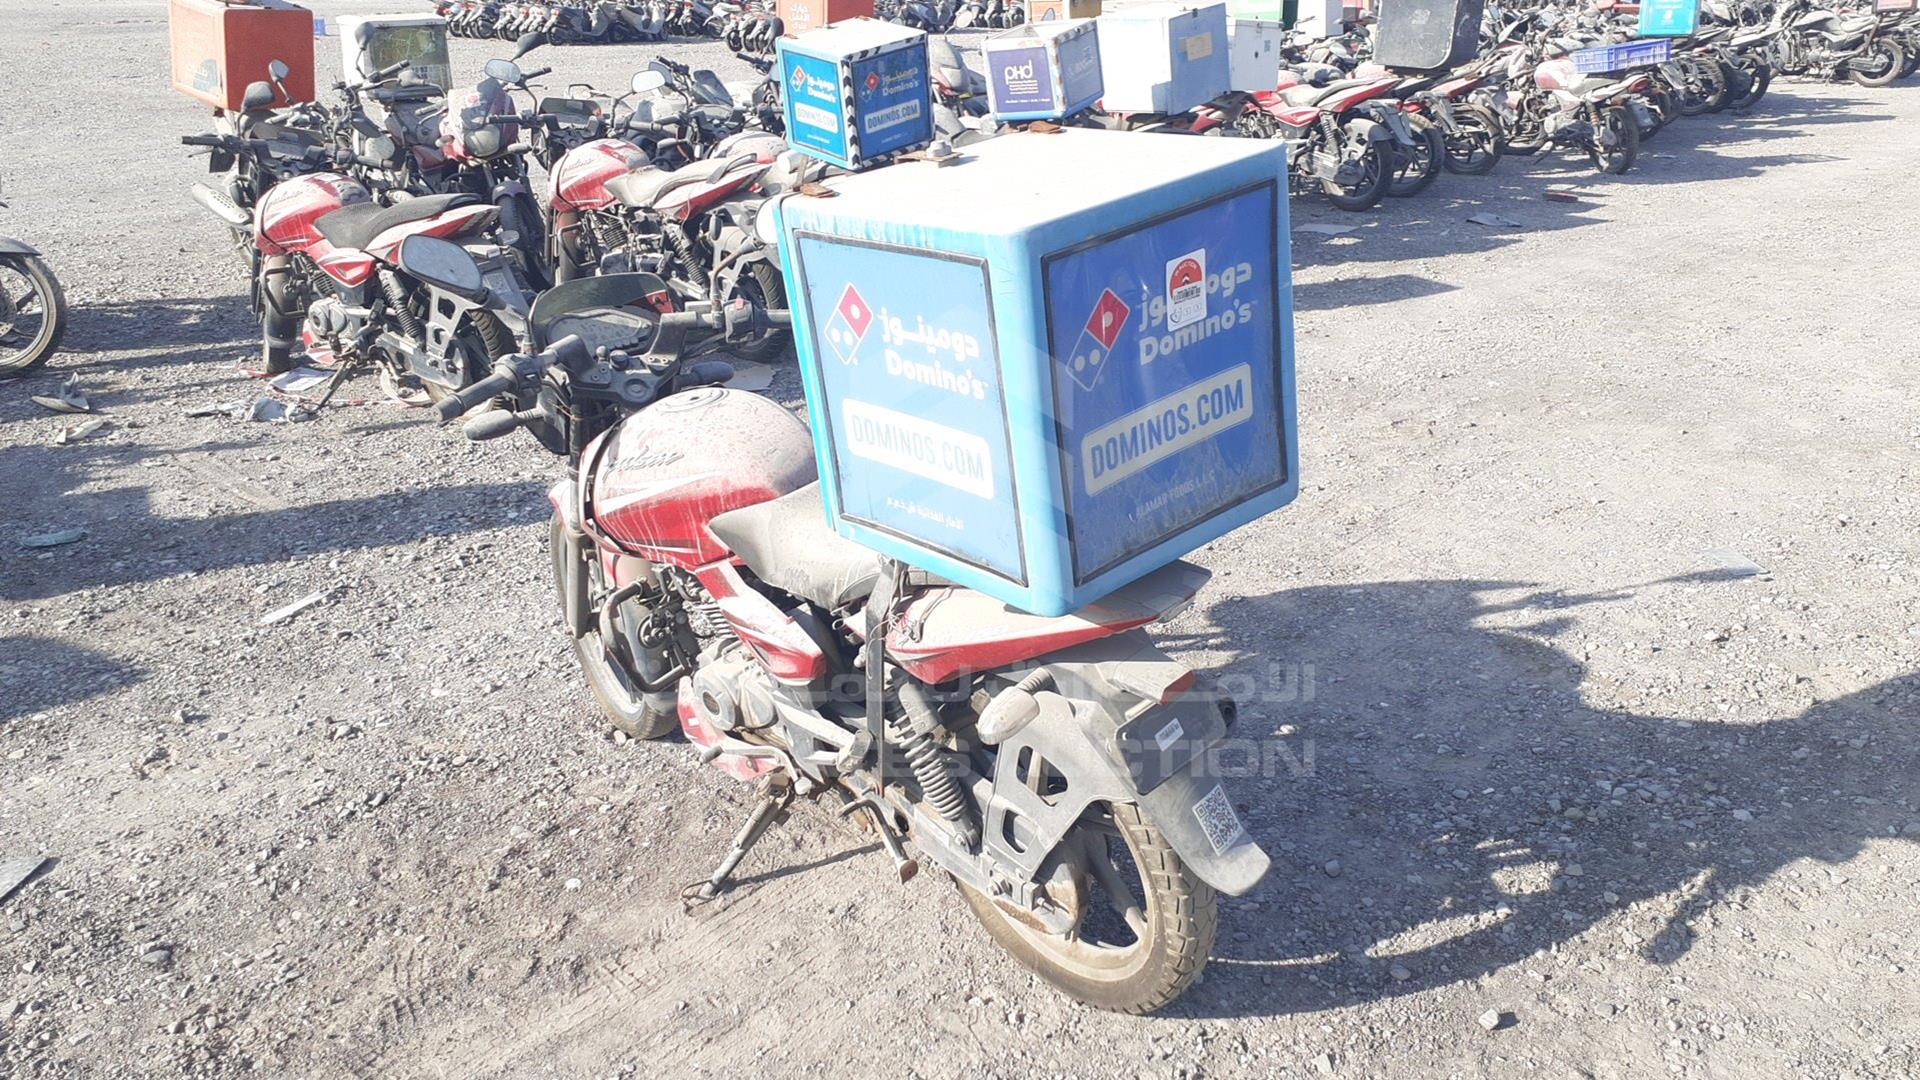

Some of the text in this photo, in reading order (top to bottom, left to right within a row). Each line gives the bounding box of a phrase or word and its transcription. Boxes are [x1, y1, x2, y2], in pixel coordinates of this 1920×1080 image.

[867, 104, 918, 128] DOMINOS.COM
[882, 80, 919, 97] Domino's
[1139, 262, 1252, 332] دوموز
[881, 306, 980, 362] دومينوز
[1139, 299, 1252, 366] Domino's
[884, 348, 985, 400] Domino's
[852, 414, 985, 481] DOMINOS.COM
[1090, 378, 1244, 480] DOMINOS.COM
